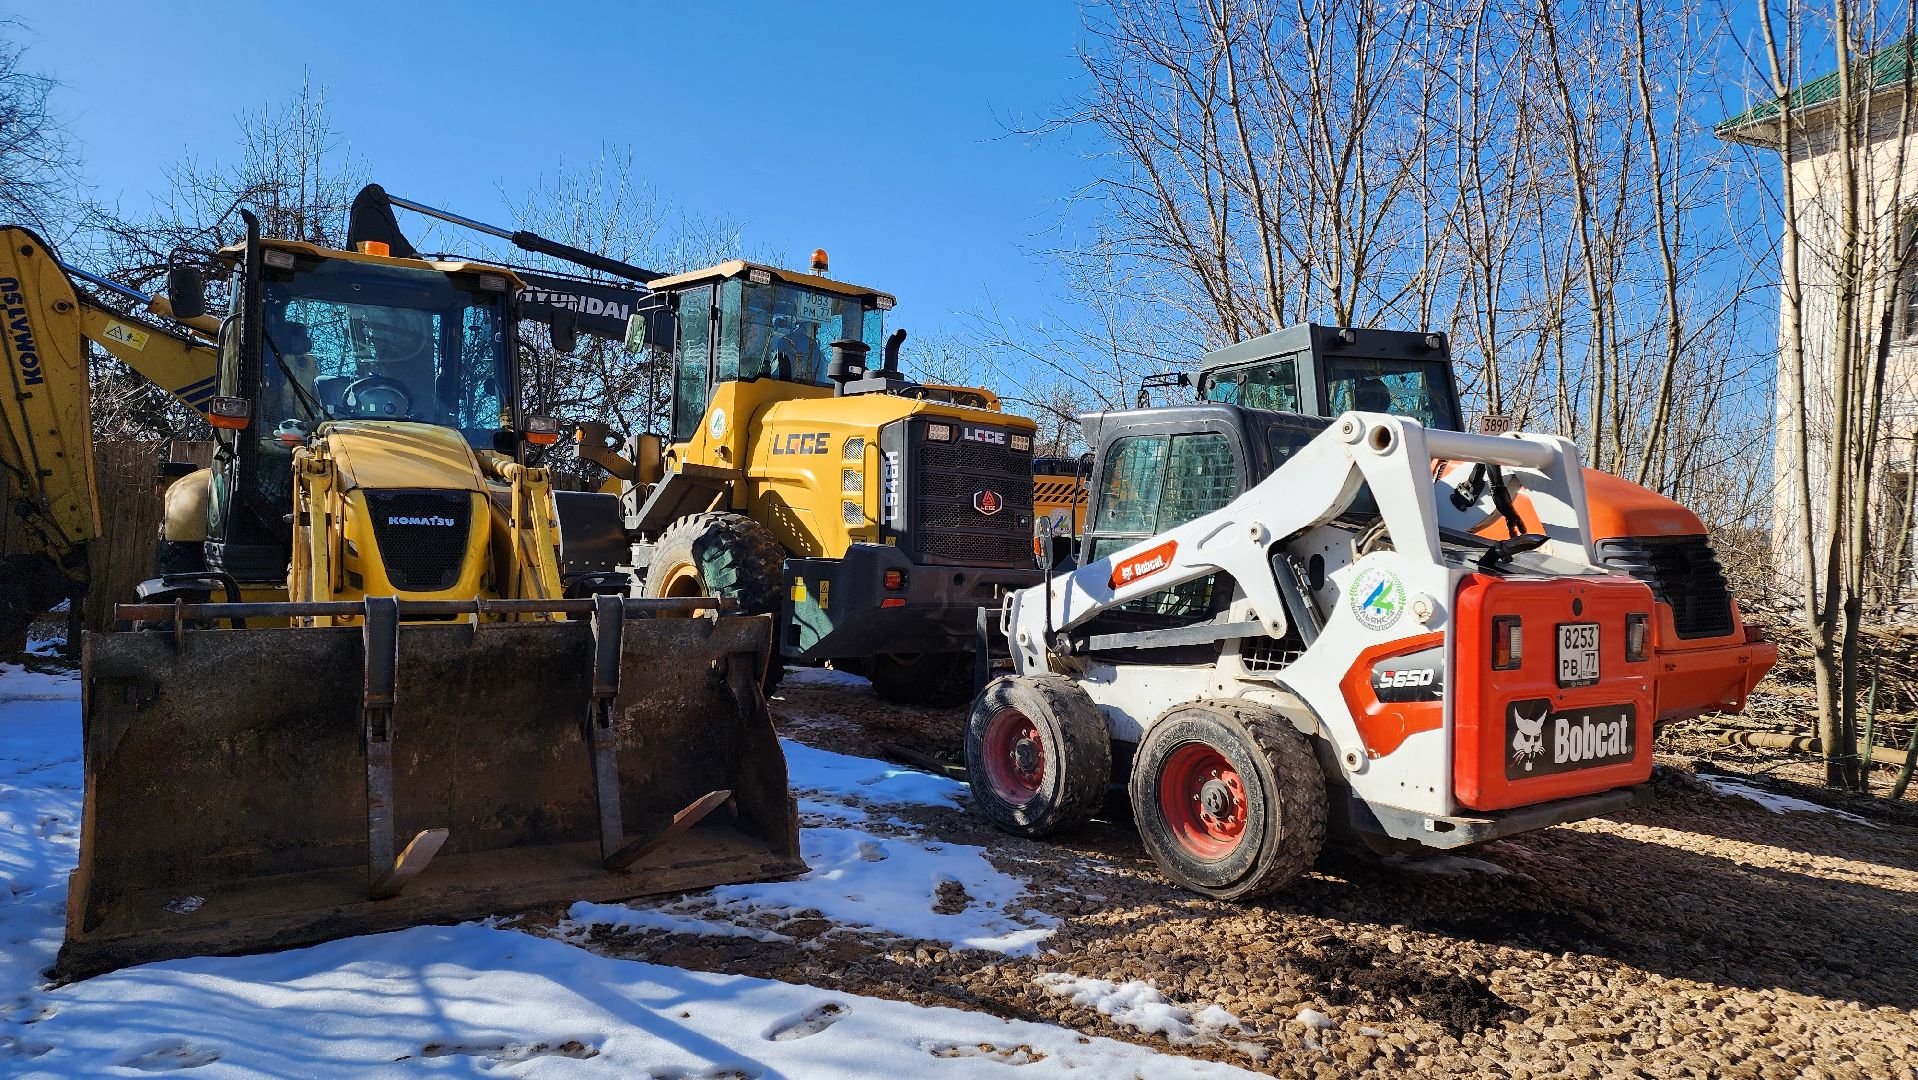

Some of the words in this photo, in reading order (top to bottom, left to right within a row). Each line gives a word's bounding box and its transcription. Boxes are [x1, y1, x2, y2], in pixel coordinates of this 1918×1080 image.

[0, 277, 44, 385] KOMATSU
[1484, 418, 1509, 432] 3890
[388, 515, 455, 527] KOMATSU
[1135, 554, 1164, 577] Bobcat
[1564, 626, 1595, 650] 8253
[1584, 652, 1596, 670] 77
[1379, 668, 1435, 689] S650
[1554, 714, 1629, 764] Bobcat
